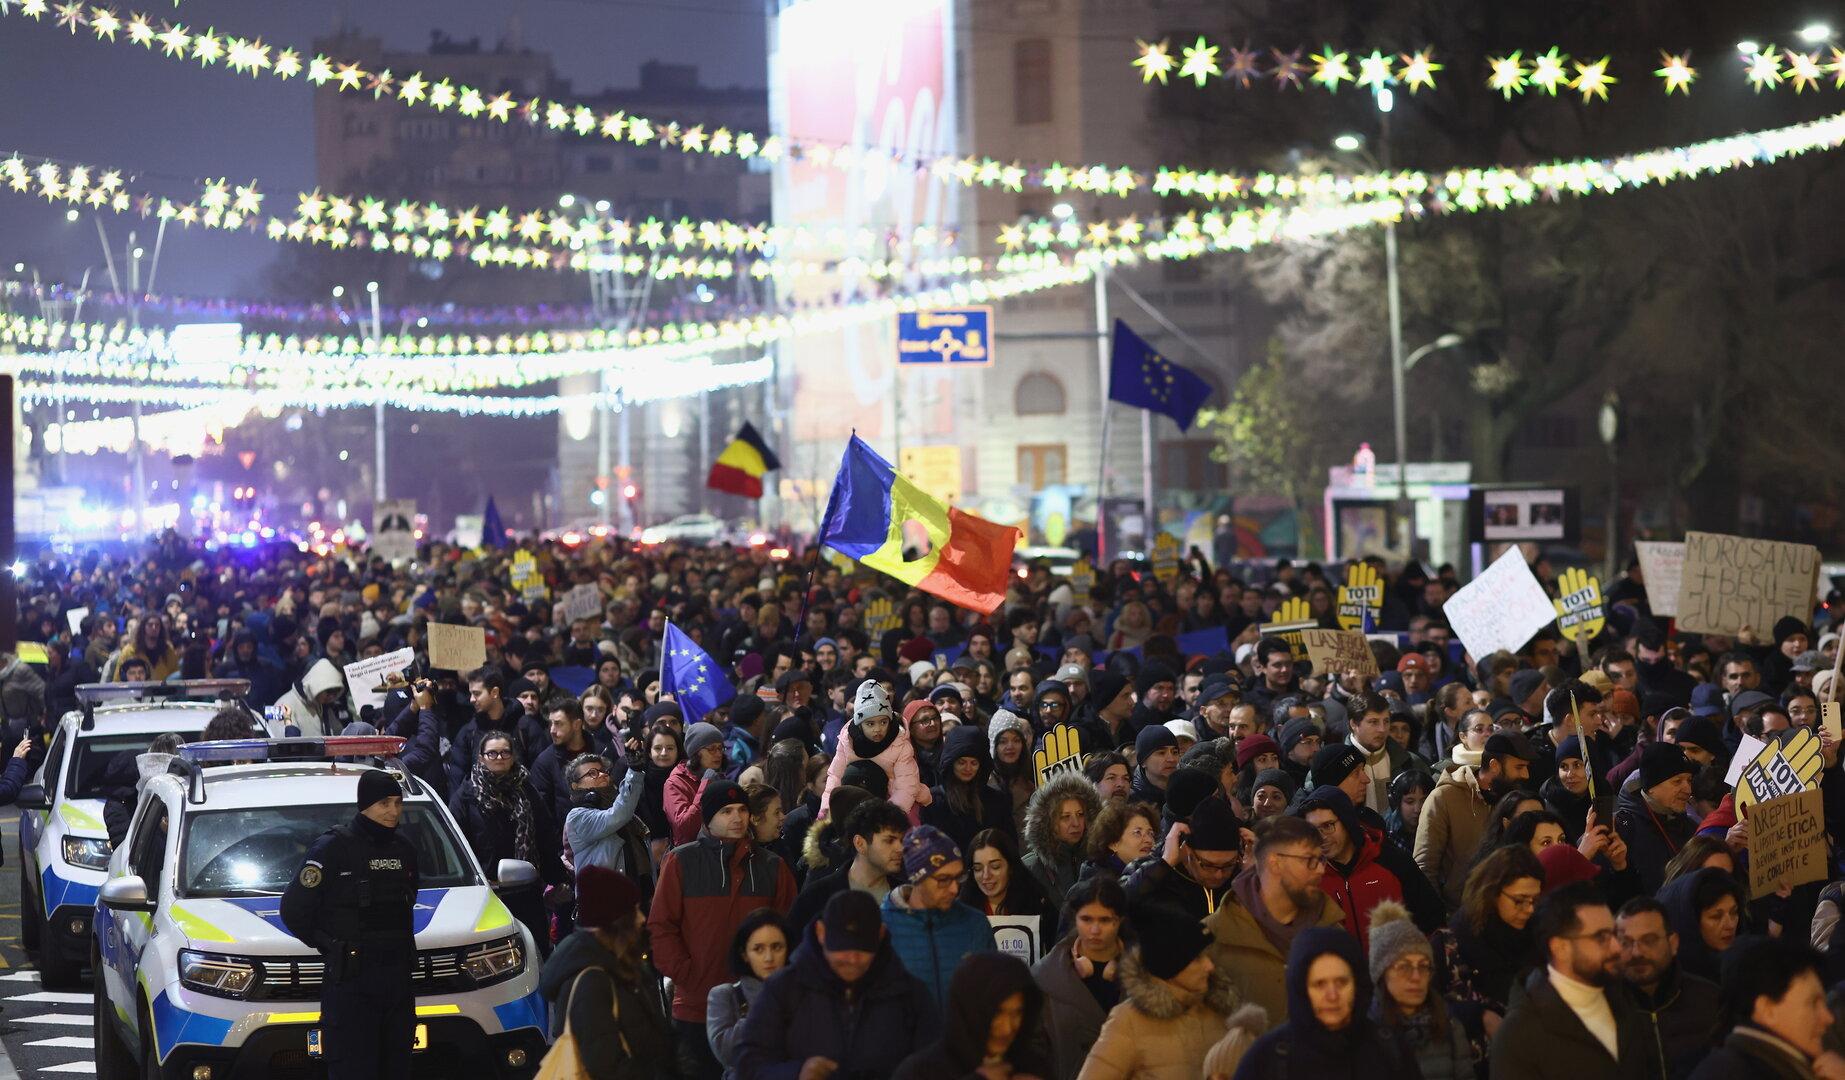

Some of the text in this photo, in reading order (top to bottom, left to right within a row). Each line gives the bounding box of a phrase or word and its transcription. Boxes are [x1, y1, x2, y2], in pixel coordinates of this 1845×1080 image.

[1747, 766, 1772, 804] JUST
[1753, 797, 1809, 837] DREPTUL
[1787, 815, 1818, 839] ETICA
[309, 1043, 319, 1053] RO
